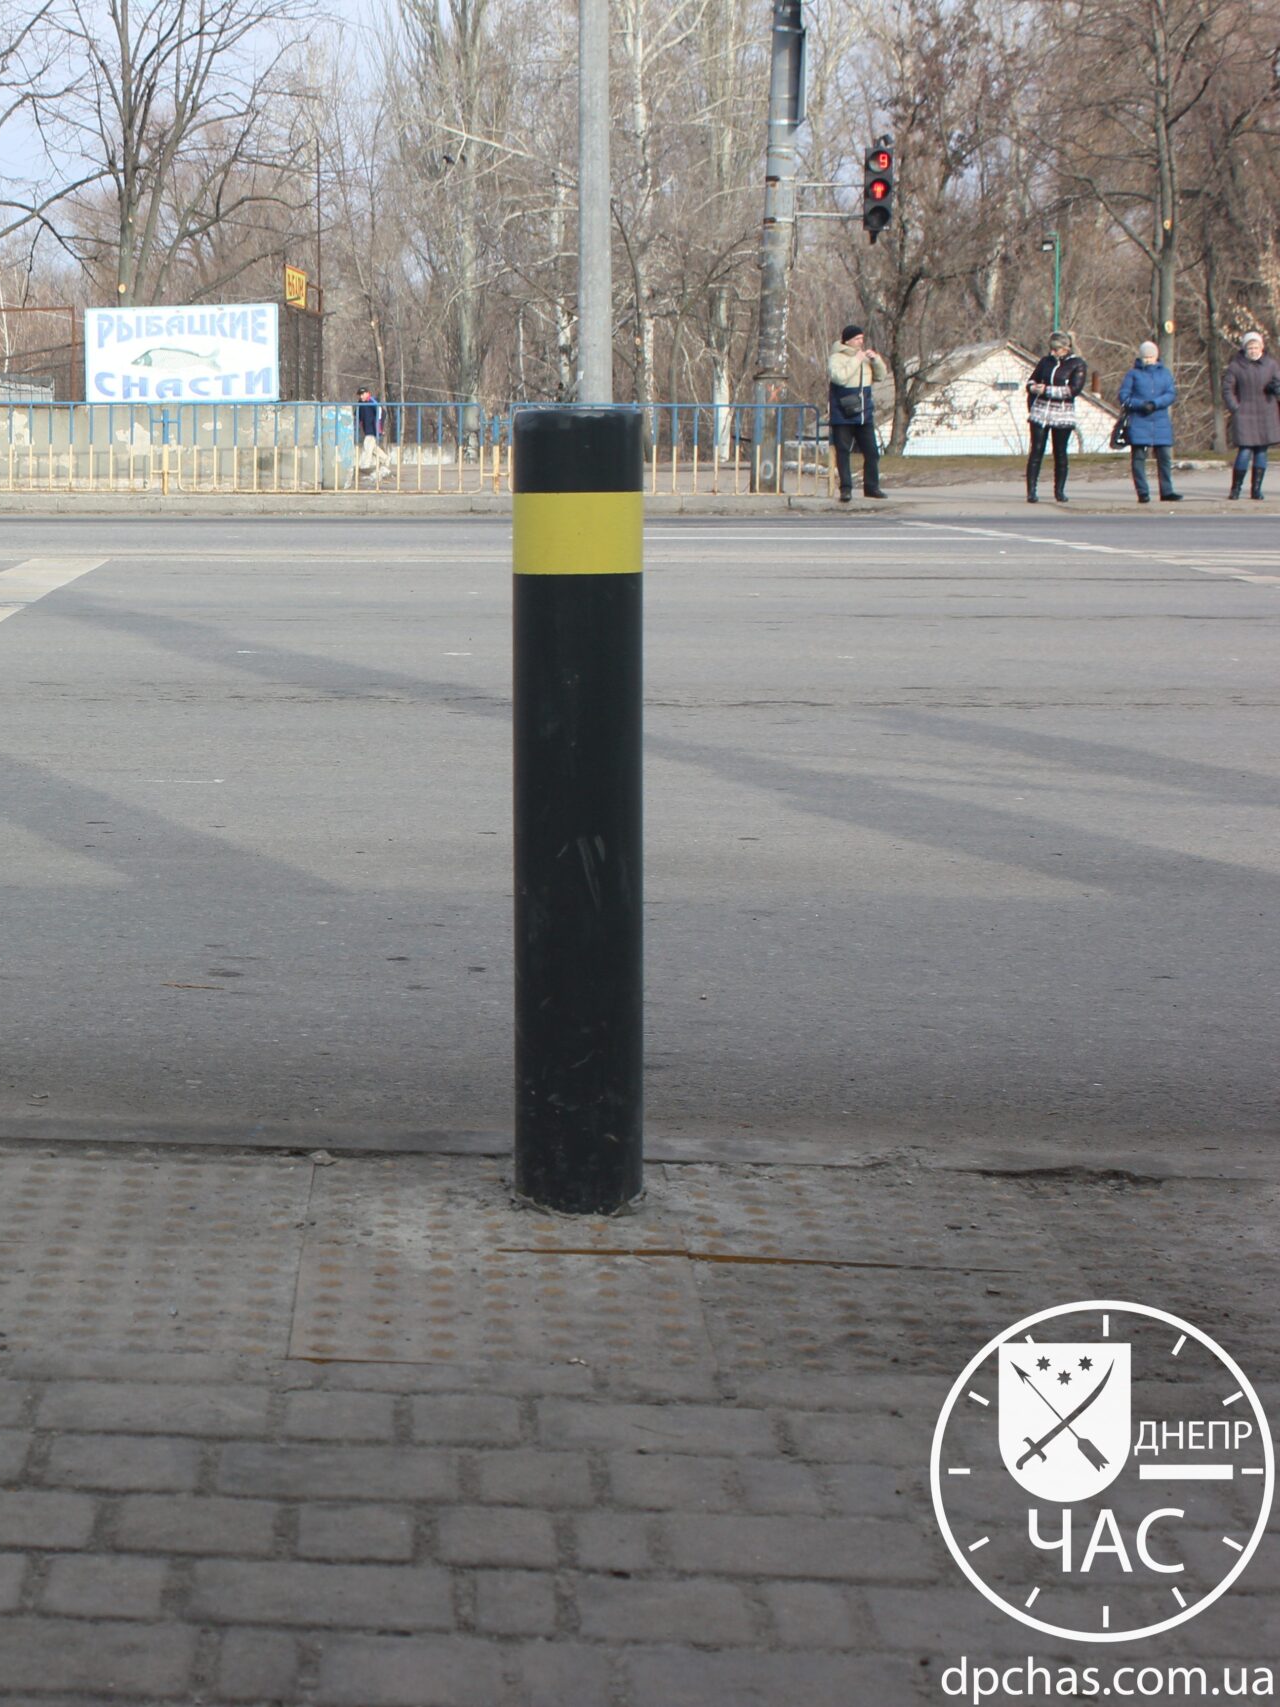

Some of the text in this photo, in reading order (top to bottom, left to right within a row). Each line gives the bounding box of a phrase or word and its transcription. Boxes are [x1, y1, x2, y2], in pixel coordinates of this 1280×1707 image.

[879, 153, 889, 169] 9
[96, 308, 268, 349] РЫБАЦКИЕ
[94, 366, 273, 400] СНАСТИ
